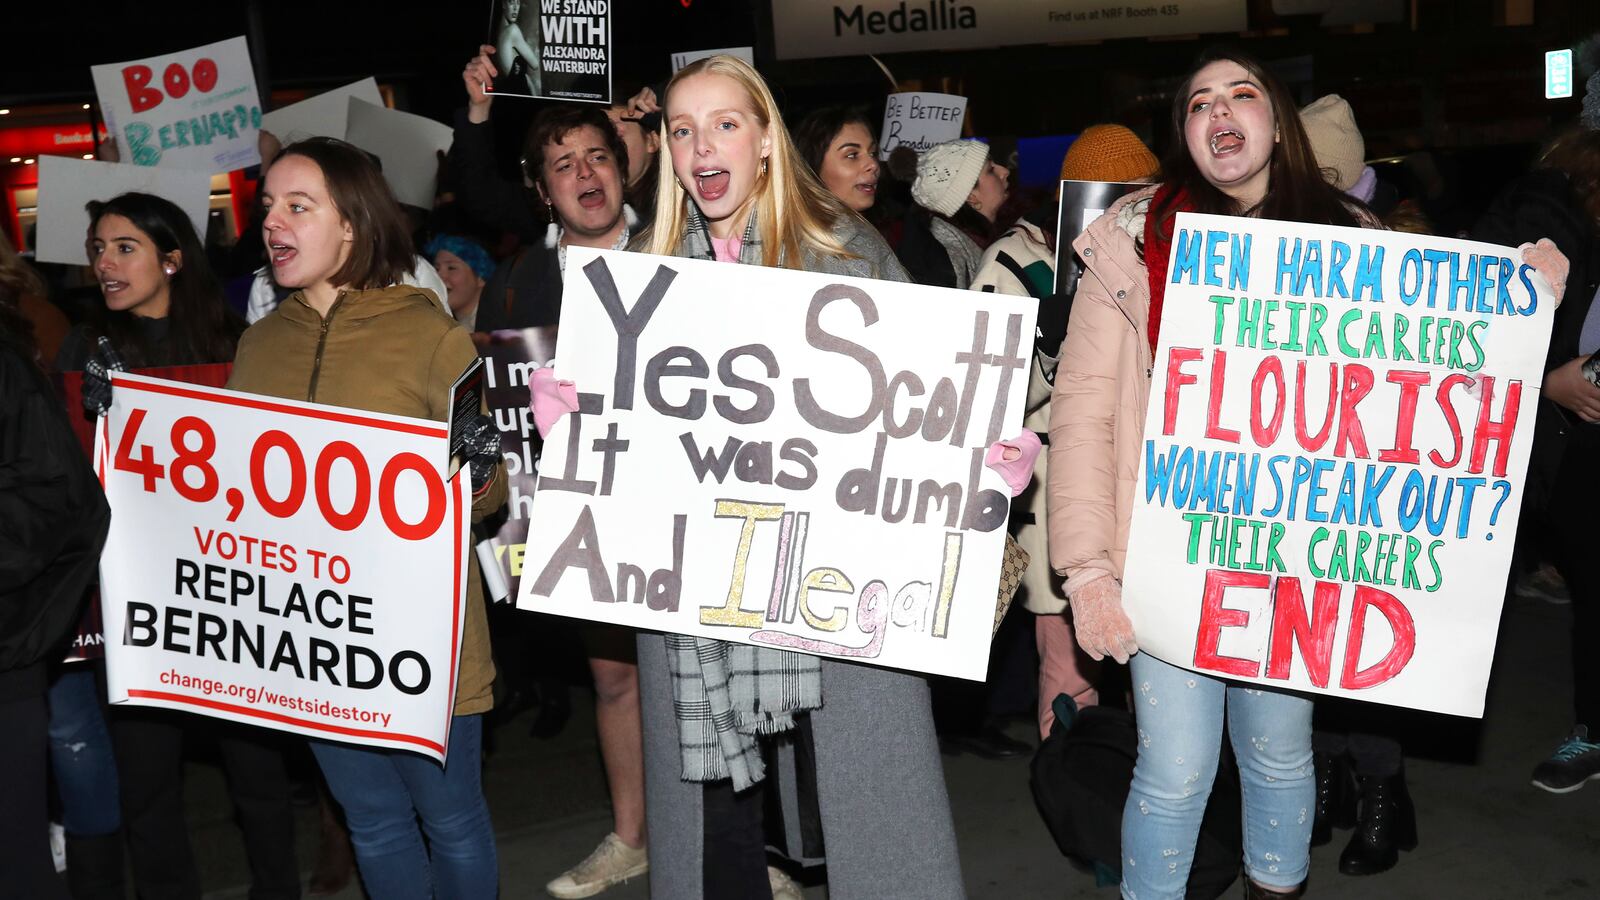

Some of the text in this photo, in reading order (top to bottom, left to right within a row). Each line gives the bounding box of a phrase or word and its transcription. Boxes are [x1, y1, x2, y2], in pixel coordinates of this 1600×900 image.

[541, 0, 607, 15] WE STAND
[541, 16, 605, 45] WITH
[832, 0, 977, 37] Medallia
[1050, 5, 1179, 22] Find us at NRF Booth 435
[122, 58, 218, 114] BOO
[543, 46, 605, 60] ALEXANDRA
[543, 60, 607, 75] WATERBURY
[124, 104, 263, 167] BERNARDO
[887, 96, 961, 122] BE BETTER
[1171, 229, 1538, 316] MEN HARM OTHERS
[583, 255, 1026, 448] Yes Scott
[1208, 295, 1488, 372] THEIR CAREERS
[1162, 347, 1523, 477] FLOURISH
[114, 408, 447, 541] 48,000
[537, 393, 629, 496] It
[679, 432, 818, 490] was
[836, 432, 1010, 534] dumb
[1146, 440, 1512, 541] WOMEN SPEAK OUT?
[193, 526, 352, 584] VOTES TO
[531, 497, 963, 658] And Illegal
[1182, 513, 1445, 592] THEIR CAREERS
[175, 558, 374, 635] REPLACE
[1193, 569, 1417, 690] END
[122, 601, 432, 696] BERNARDO
[160, 669, 392, 727] change.org/westsidestory
